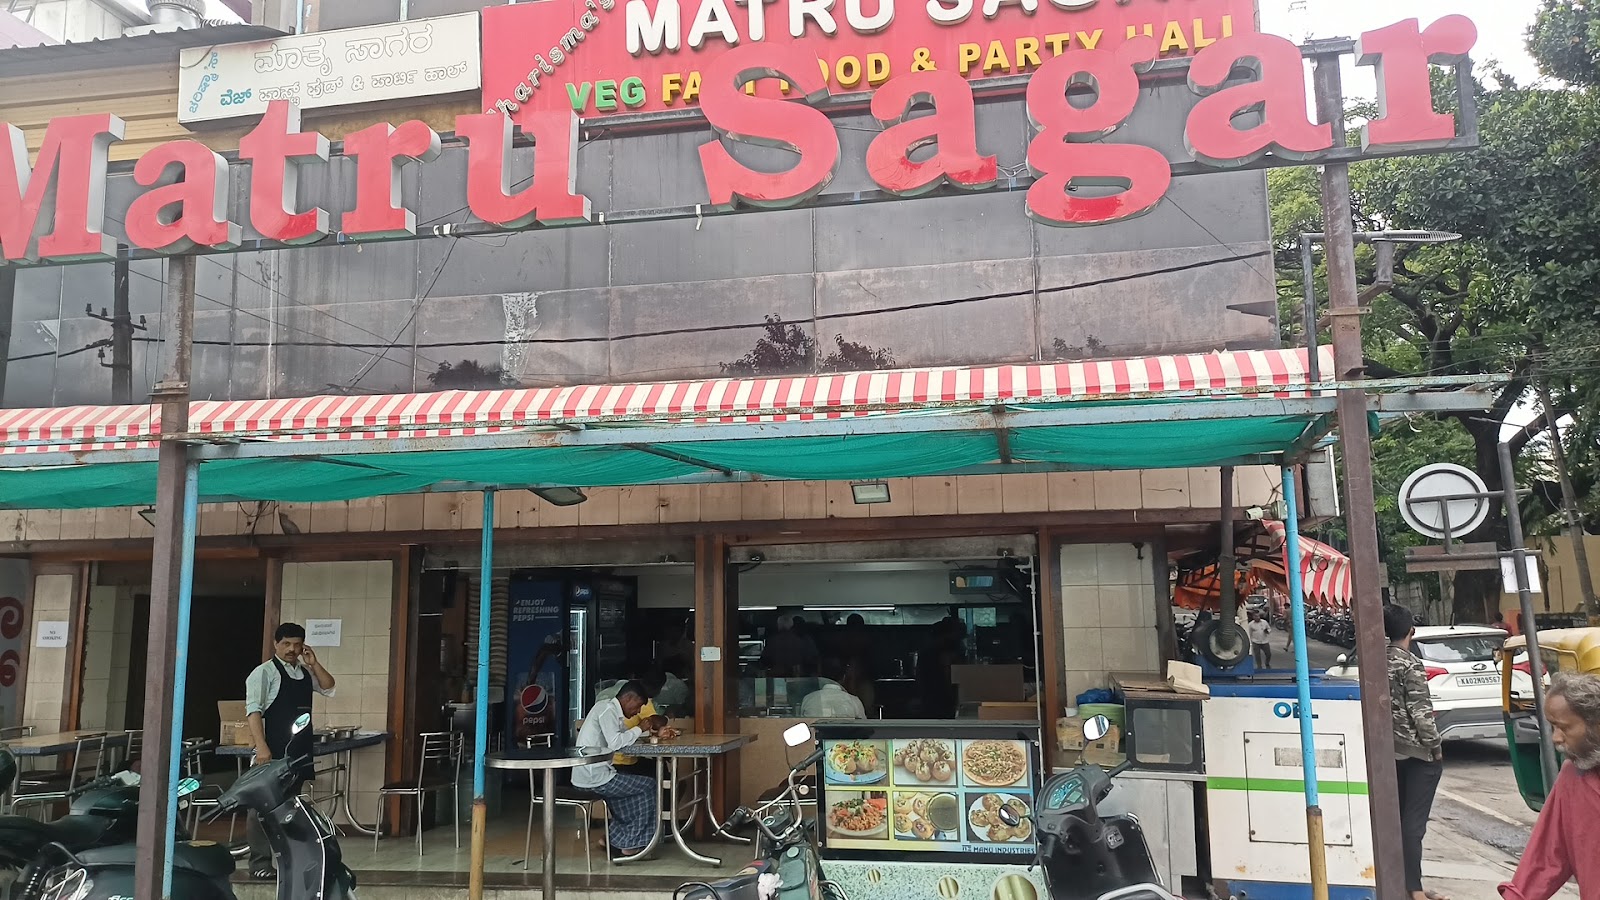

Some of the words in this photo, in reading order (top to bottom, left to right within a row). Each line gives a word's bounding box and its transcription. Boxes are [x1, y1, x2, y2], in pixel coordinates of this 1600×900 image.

[345, 23, 434, 64] ಸಾಗರ
[486, 0, 615, 117] harisma's
[219, 88, 253, 107] ವೆಜ್
[351, 75, 365, 92] &
[424, 60, 468, 82] ಹಾಲ್
[565, 76, 646, 114] VEG
[910, 47, 937, 73] &
[958, 28, 1104, 75] PARTY
[697, 13, 1478, 222] Sagar
[512, 614, 535, 622] PEPSI
[513, 606, 560, 614] REFRESHING
[520, 598, 546, 606] ENJOY
[522, 716, 545, 725] pepsi
